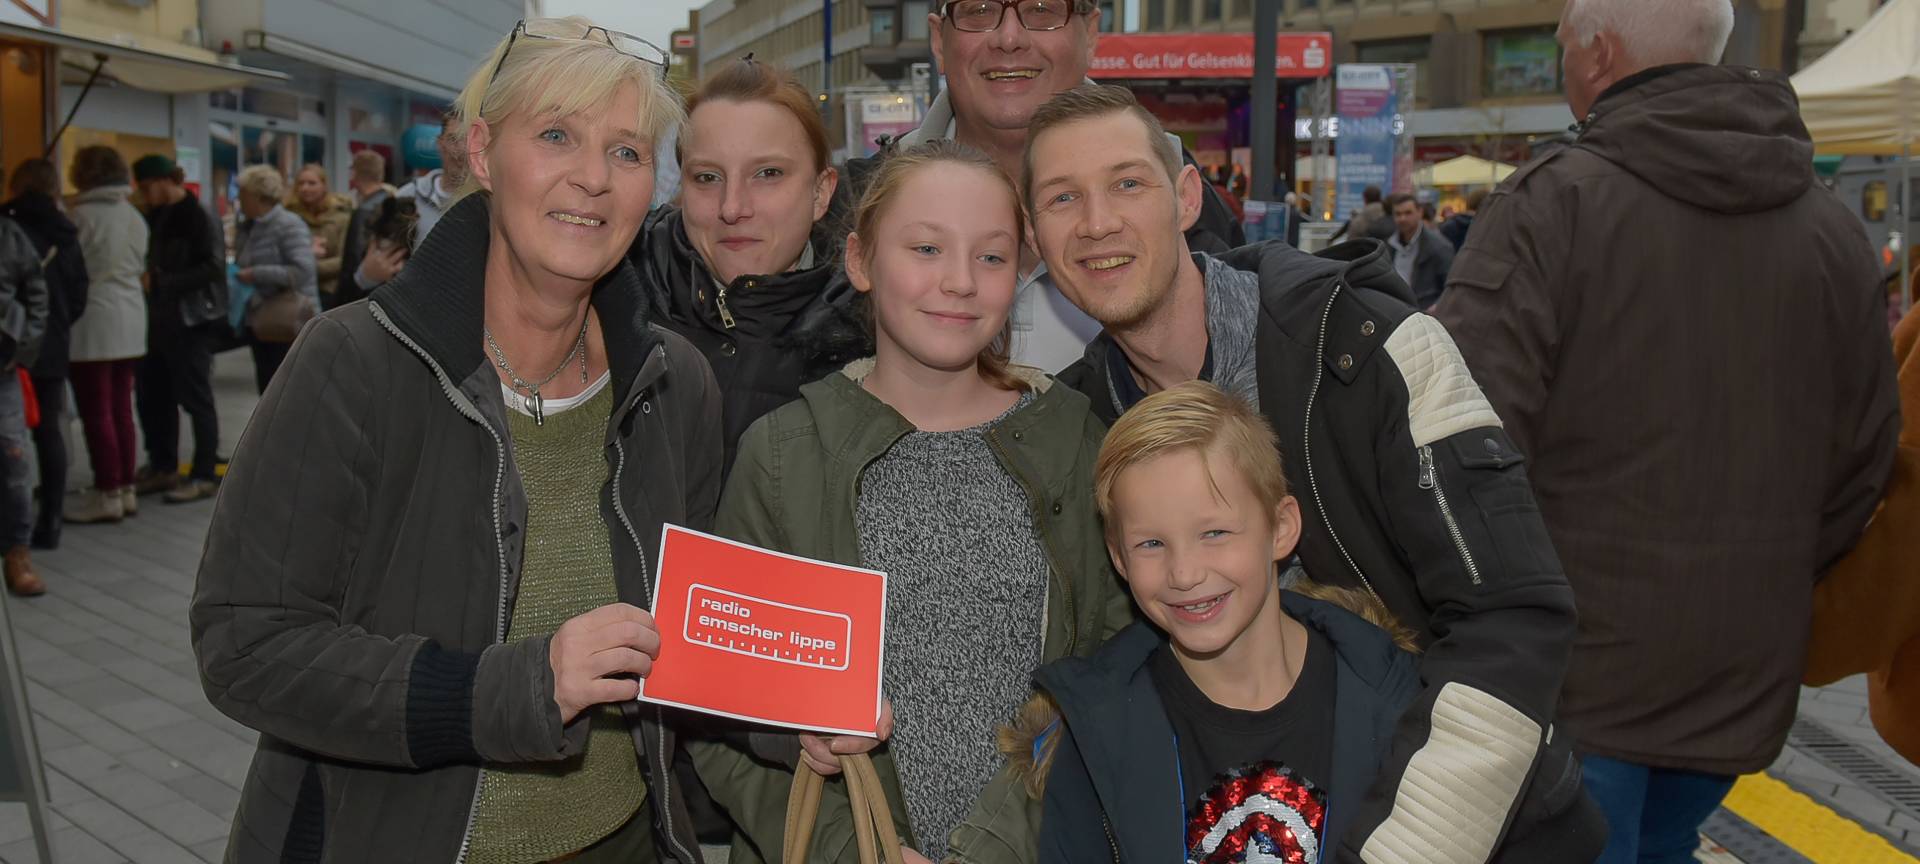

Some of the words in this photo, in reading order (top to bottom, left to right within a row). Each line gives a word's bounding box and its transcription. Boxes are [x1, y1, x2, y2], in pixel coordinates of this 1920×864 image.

[1133, 53, 1160, 69] Gut
[1163, 52, 1184, 69] für
[701, 598, 751, 618] radio
[699, 615, 783, 641] emscher
[789, 631, 836, 651] lippe
